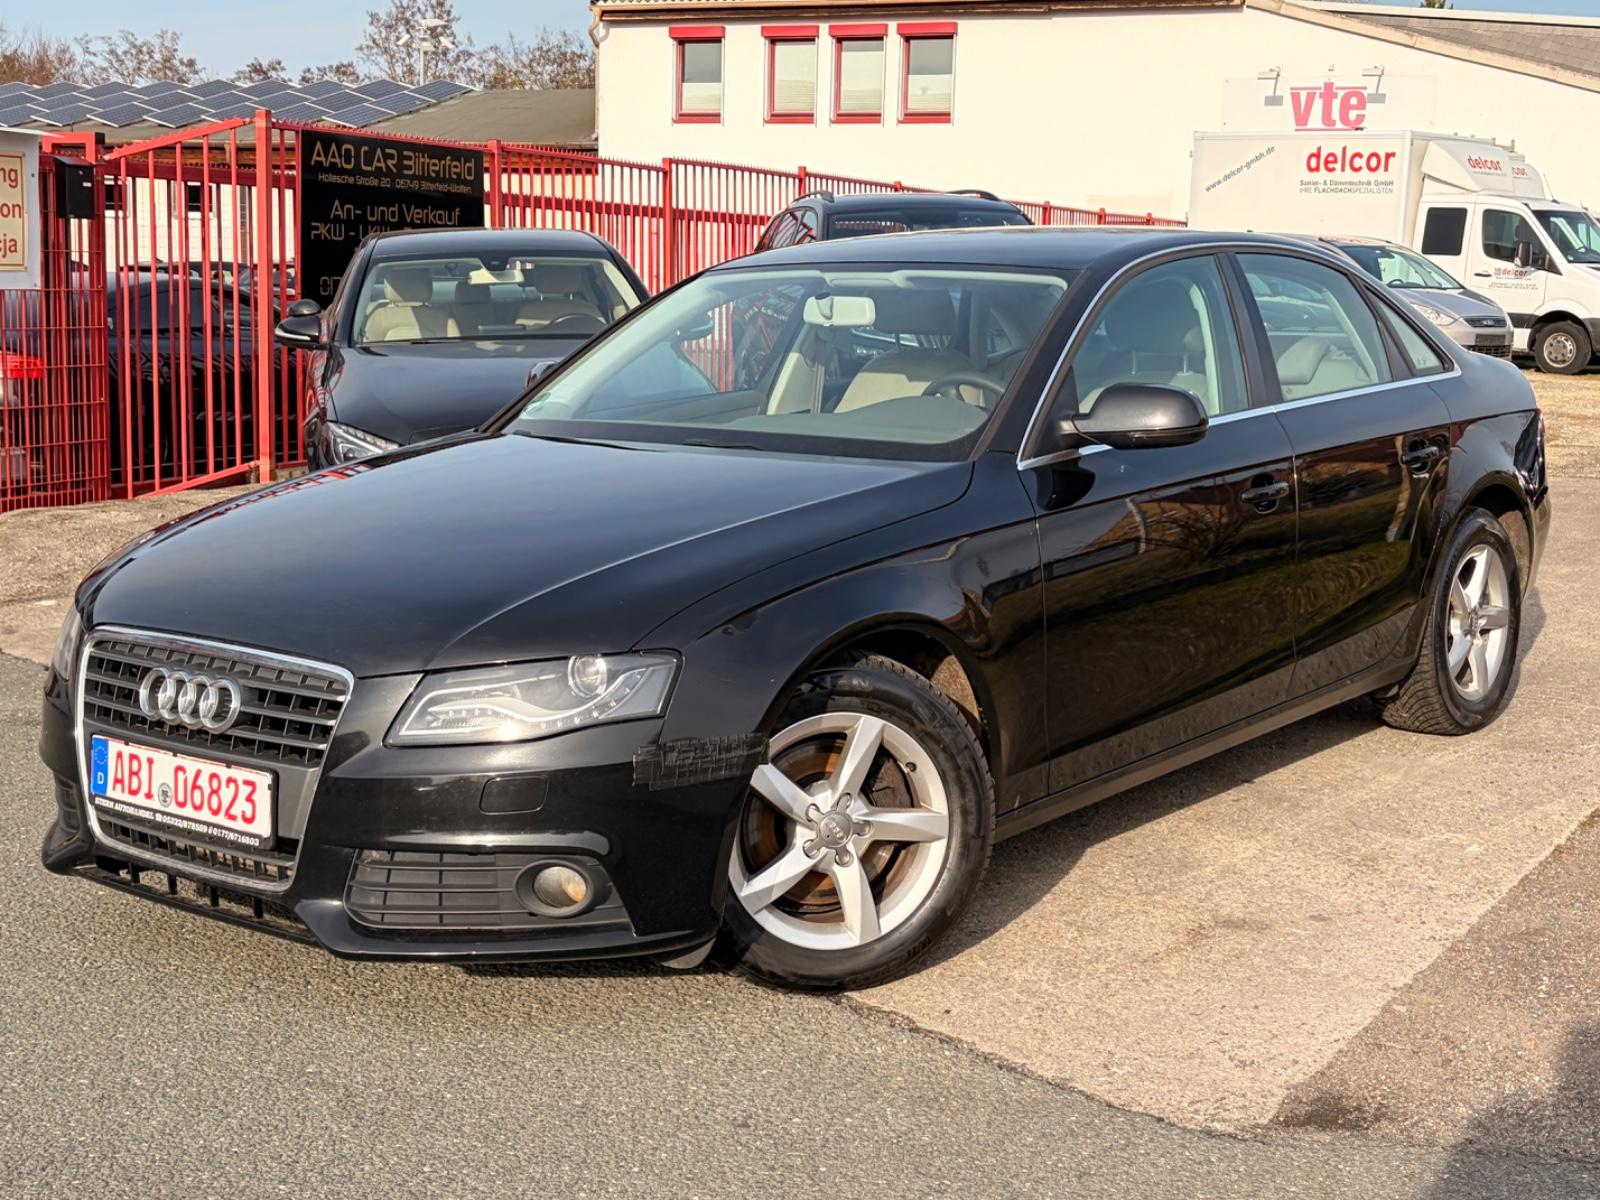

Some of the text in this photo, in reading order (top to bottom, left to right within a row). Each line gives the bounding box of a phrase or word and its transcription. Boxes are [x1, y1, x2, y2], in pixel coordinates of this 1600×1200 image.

[1290, 82, 1366, 128] vte
[361, 146, 397, 173] CAR
[402, 151, 474, 180] Bitterfeld
[1204, 146, 1275, 192] www.delcor-gmbh.de
[1306, 145, 1396, 173] delcor
[1467, 154, 1502, 171] delcor
[367, 203, 398, 222] und
[402, 203, 460, 225] Verkauf
[311, 222, 344, 240] PKW
[97, 772, 104, 784] D
[112, 750, 257, 825] ABI 06823
